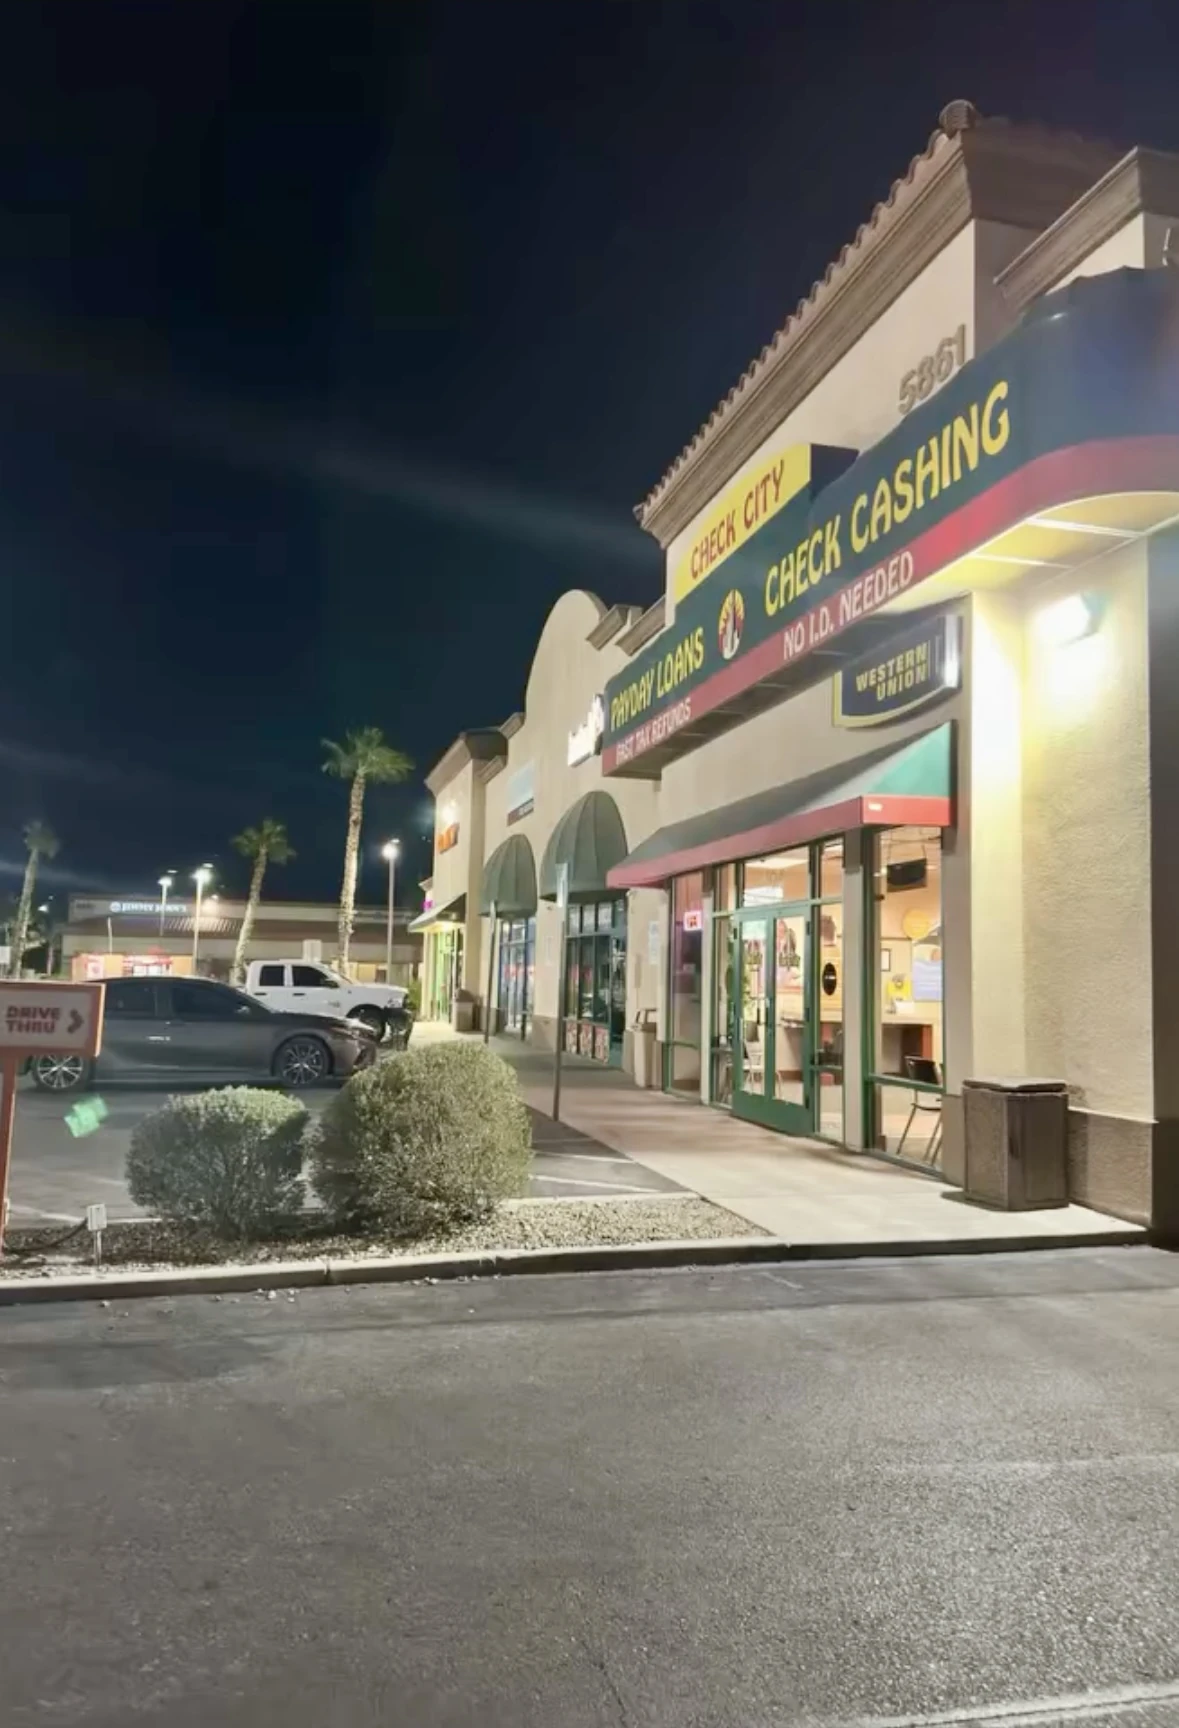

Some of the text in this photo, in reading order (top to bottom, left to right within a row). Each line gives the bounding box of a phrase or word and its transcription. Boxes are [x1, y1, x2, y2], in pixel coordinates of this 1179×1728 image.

[898, 324, 966, 415] 5861
[691, 459, 784, 579] CHECK CITY
[765, 380, 1010, 616] CHECK CASHING
[783, 550, 914, 660] NO I.D. NEEDED
[611, 667, 655, 732] PAYDAY
[657, 626, 704, 698] LOANS
[856, 641, 928, 701] WESTERN UNION
[6, 1006, 60, 1033] DRIVE THRU
